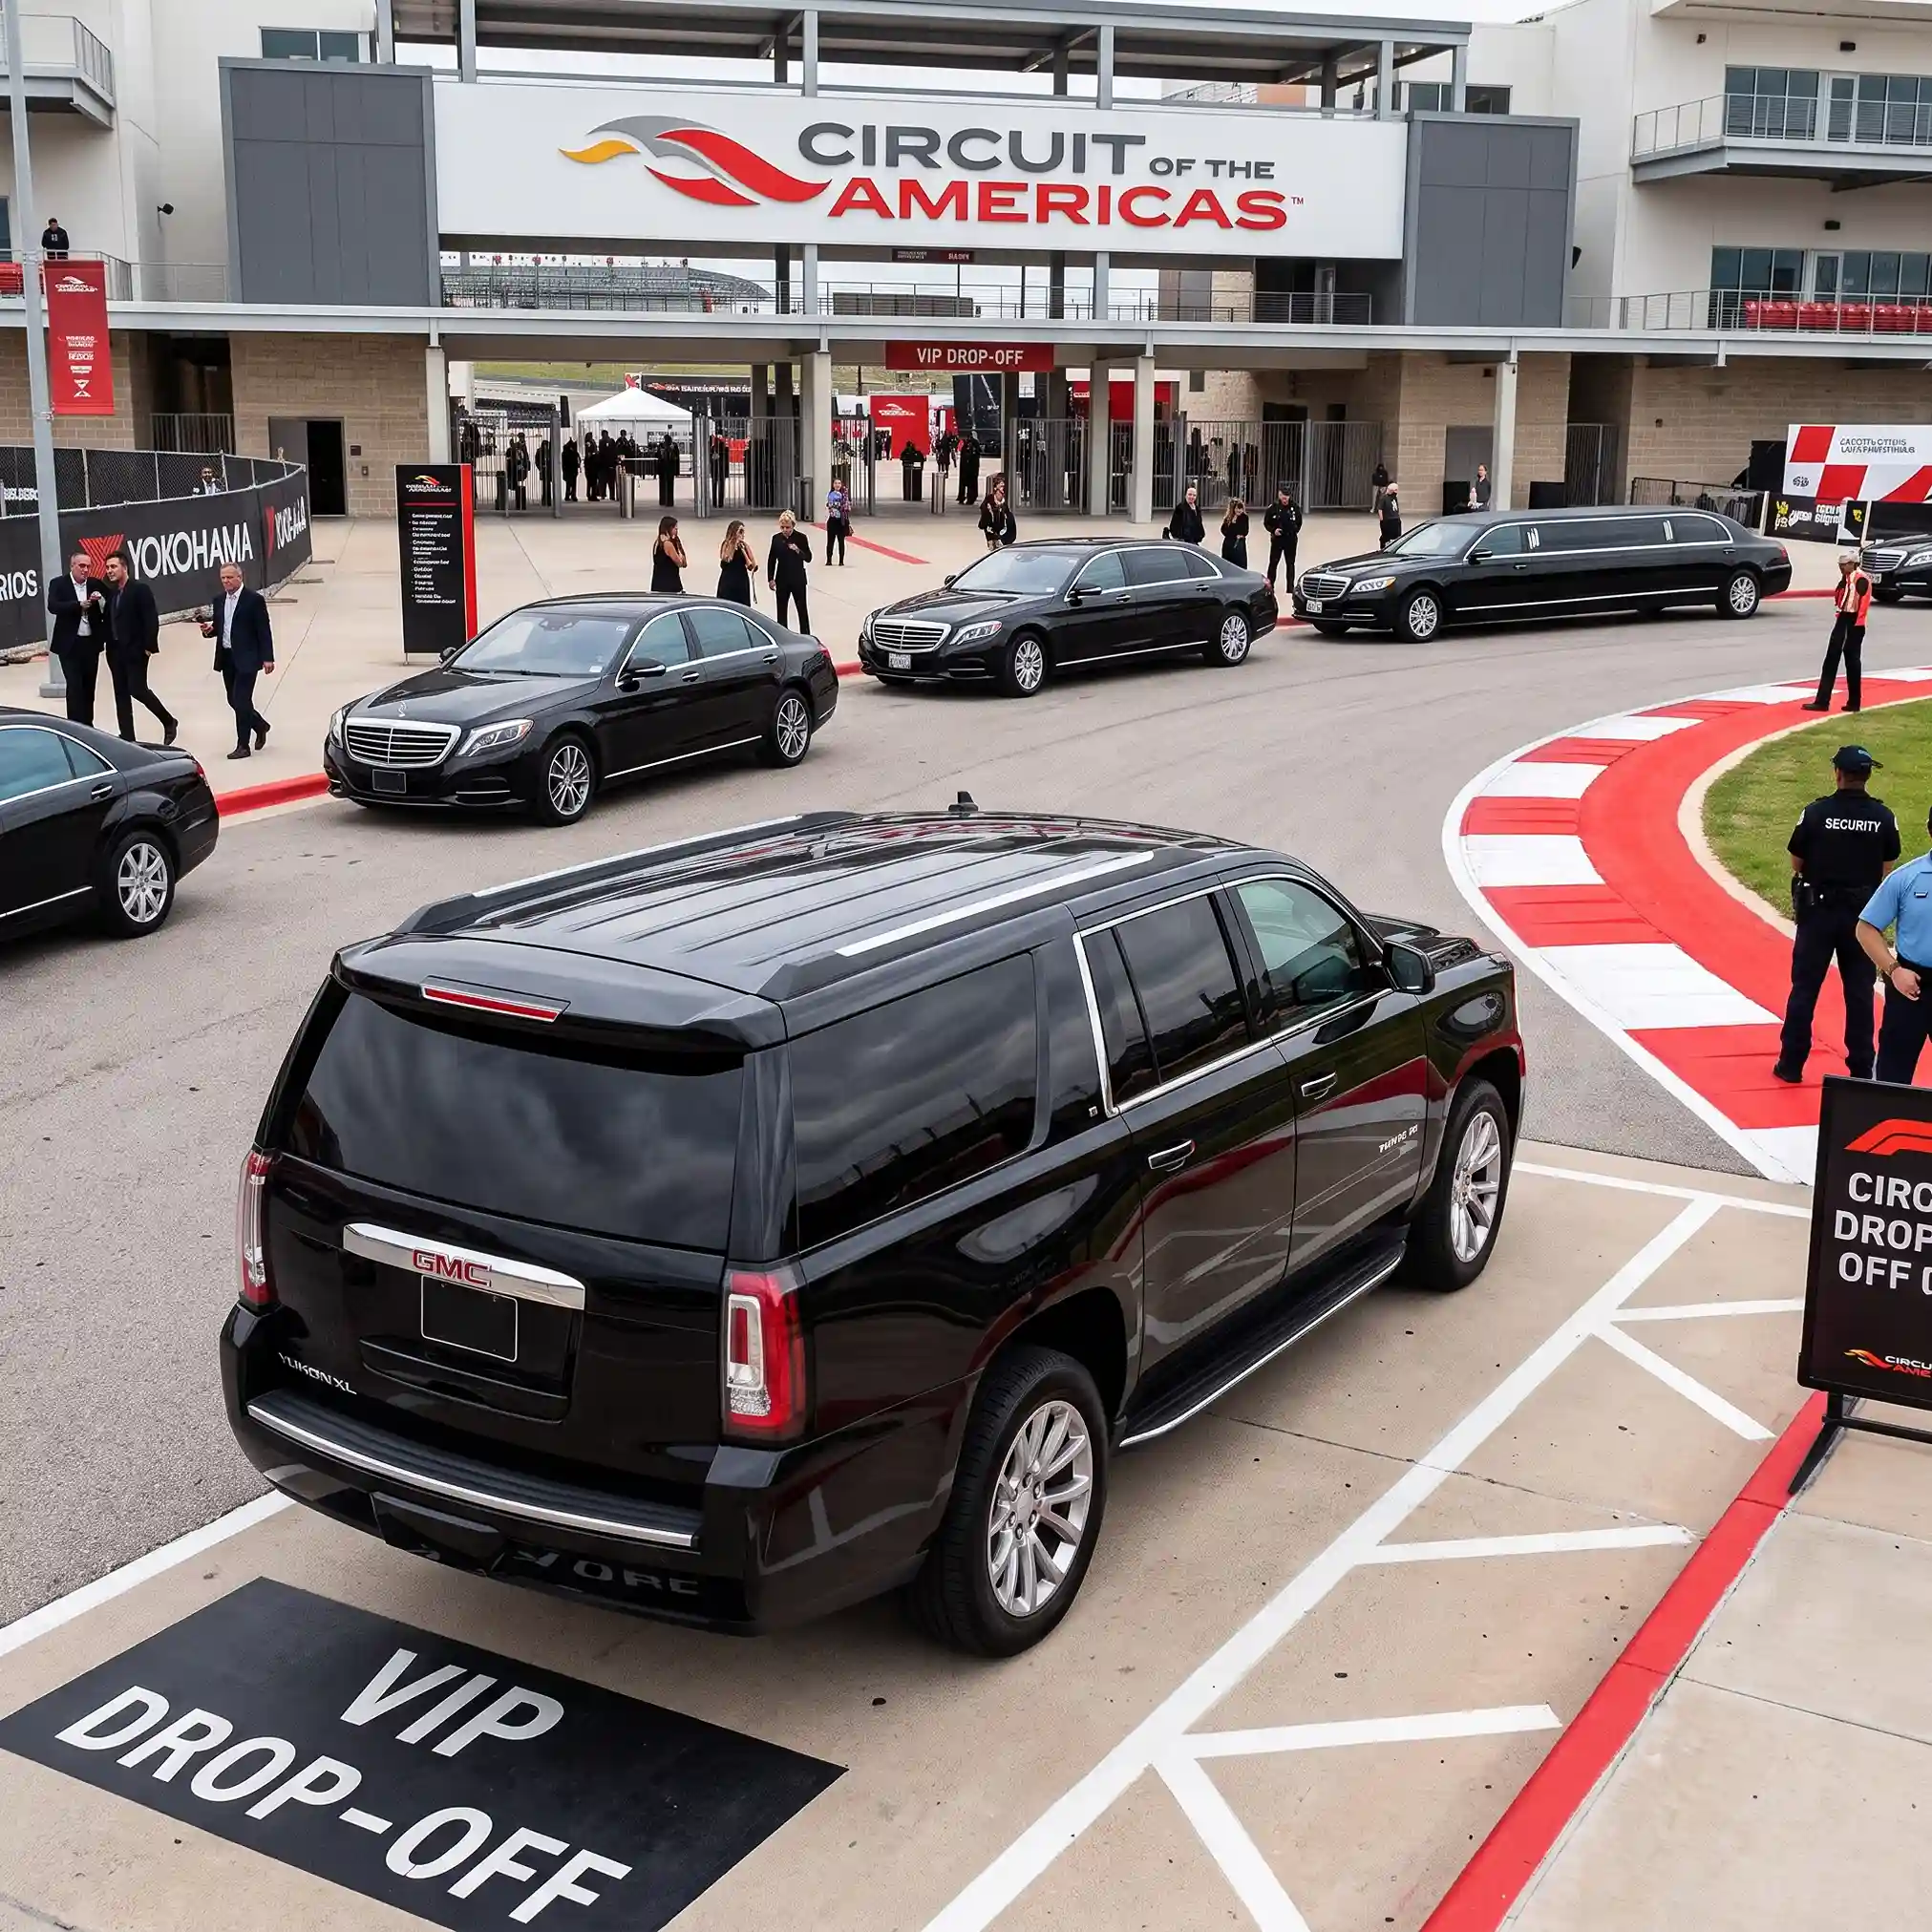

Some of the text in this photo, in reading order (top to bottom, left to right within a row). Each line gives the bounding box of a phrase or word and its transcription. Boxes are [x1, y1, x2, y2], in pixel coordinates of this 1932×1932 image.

[798, 121, 1275, 180] CIRCUIT OF THE
[827, 177, 1288, 230] AMERICAS
[917, 348, 1024, 365] VIP DROP-OFF
[127, 521, 254, 581] YOKOHAMA
[0, 569, 38, 601] RIOS
[1825, 817, 1880, 833] SECURITY
[1848, 1172, 1932, 1213] CIRC
[1834, 1209, 1932, 1252] DROP
[413, 1248, 493, 1287] GMC
[1838, 1251, 1912, 1289] OFF
[332, 1377, 358, 1395] XL
[339, 1648, 564, 1757] VIP
[53, 1686, 633, 1924] DROP-OFF
